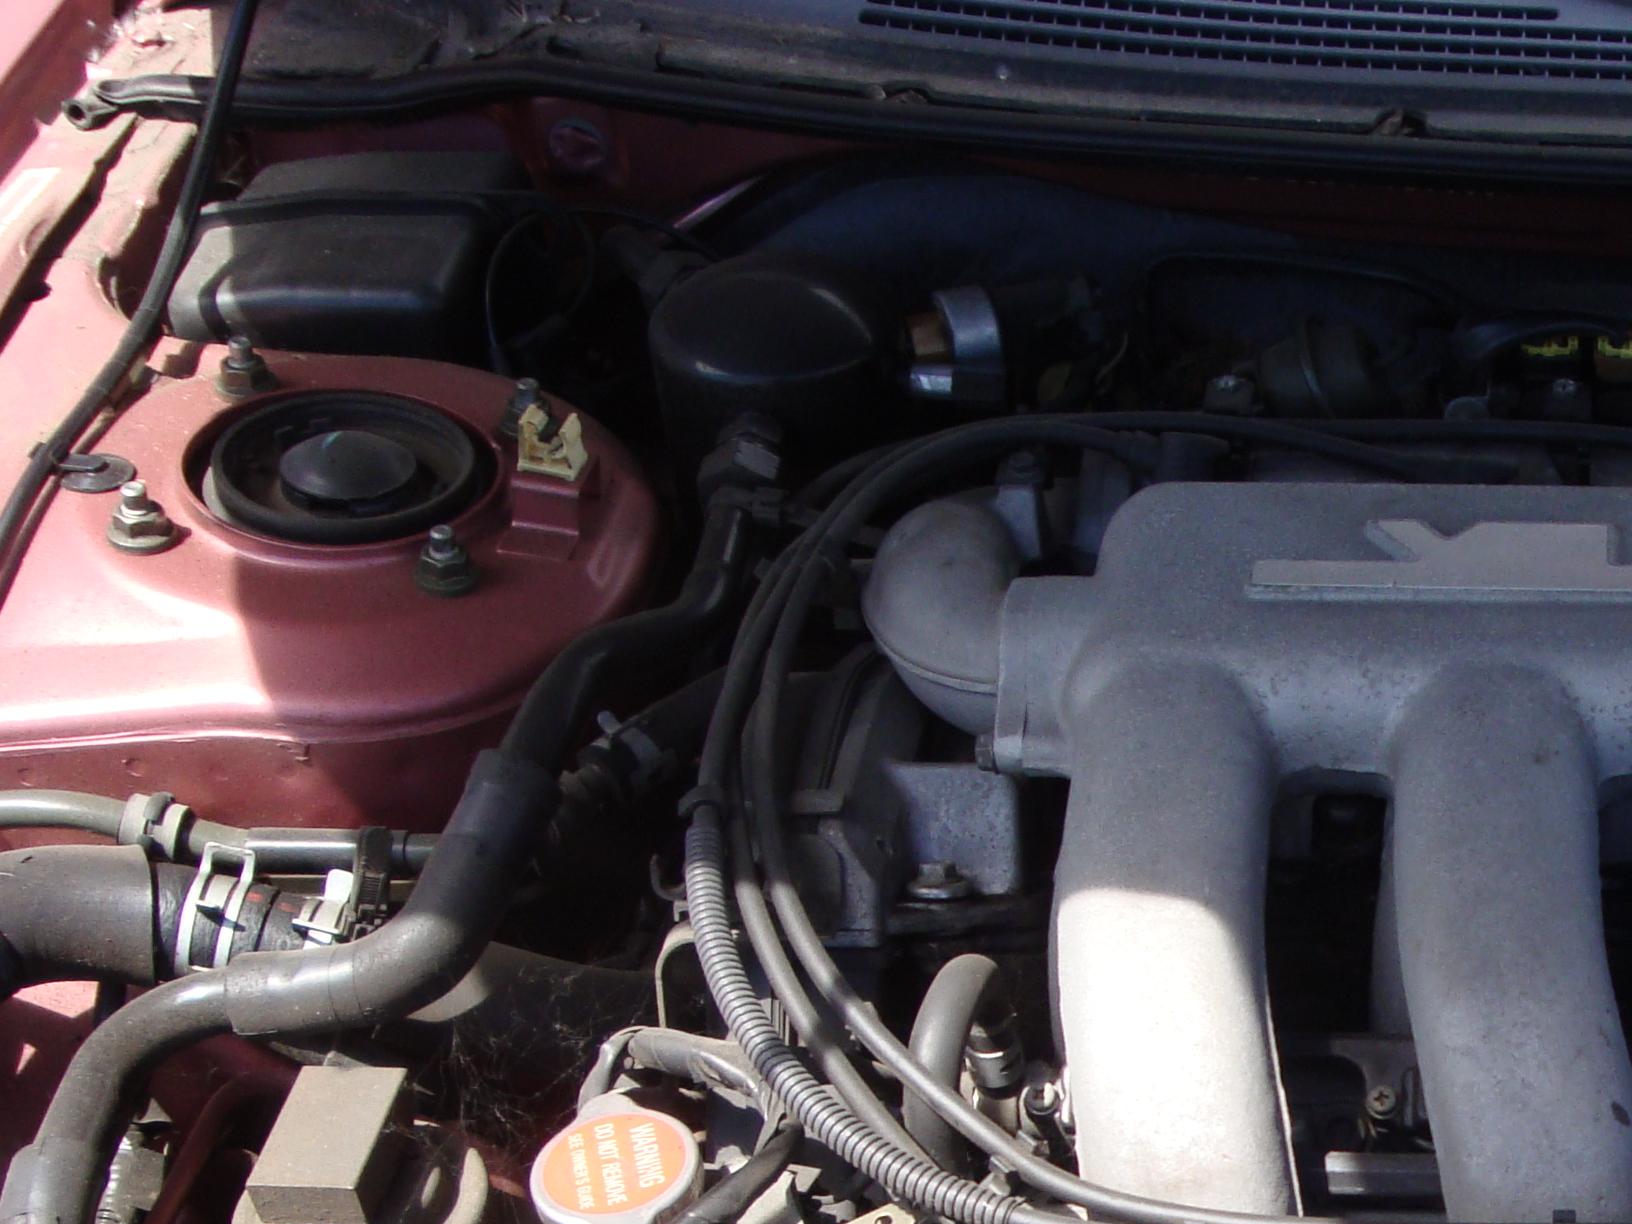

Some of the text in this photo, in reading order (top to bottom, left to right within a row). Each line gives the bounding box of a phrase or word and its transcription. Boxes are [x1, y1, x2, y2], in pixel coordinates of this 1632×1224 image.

[567, 1132, 585, 1150] SEE
[594, 1123, 628, 1206] DO NOT REMOVE
[629, 1122, 666, 1189] WARNING
